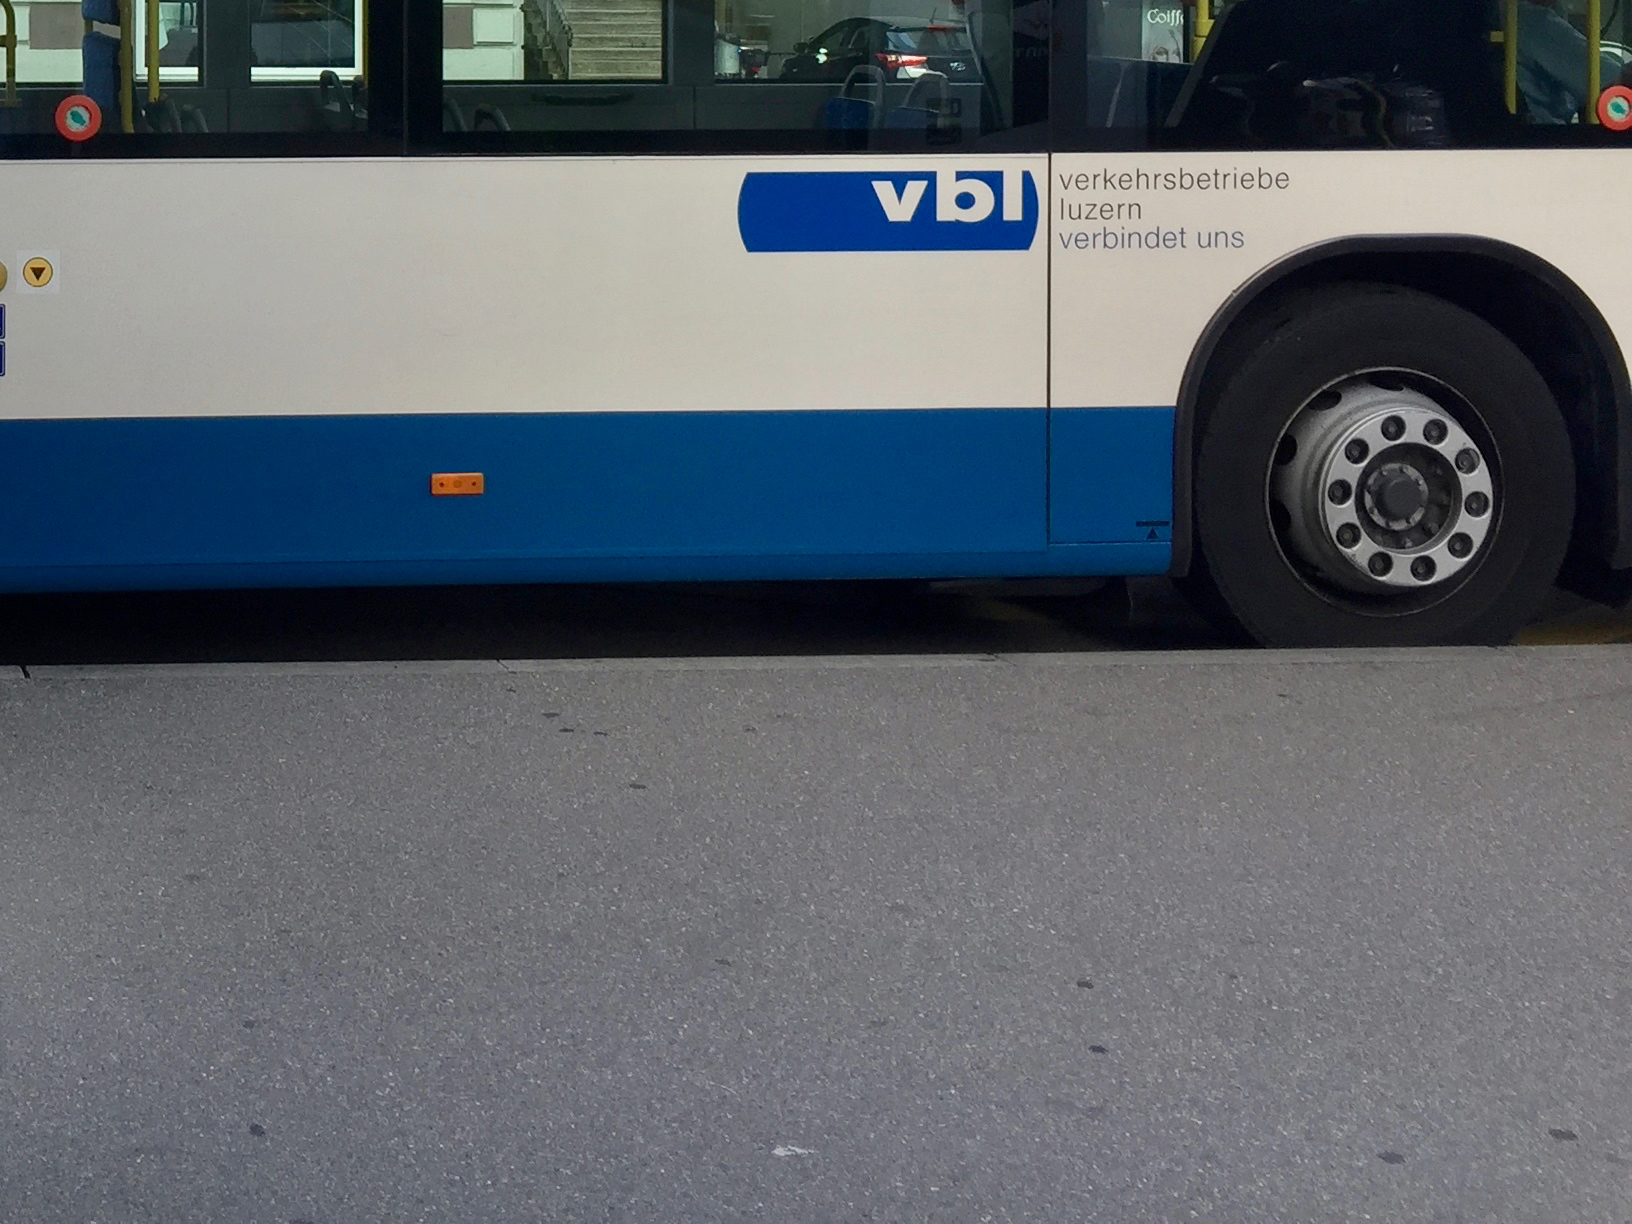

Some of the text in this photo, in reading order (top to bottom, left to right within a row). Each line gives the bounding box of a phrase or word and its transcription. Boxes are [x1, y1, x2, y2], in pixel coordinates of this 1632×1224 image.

[1058, 168, 1291, 191] verkehrsbetriebe
[871, 170, 1024, 223] vbl
[1059, 198, 1143, 221] luzern
[1058, 226, 1246, 251] verbindet uns
